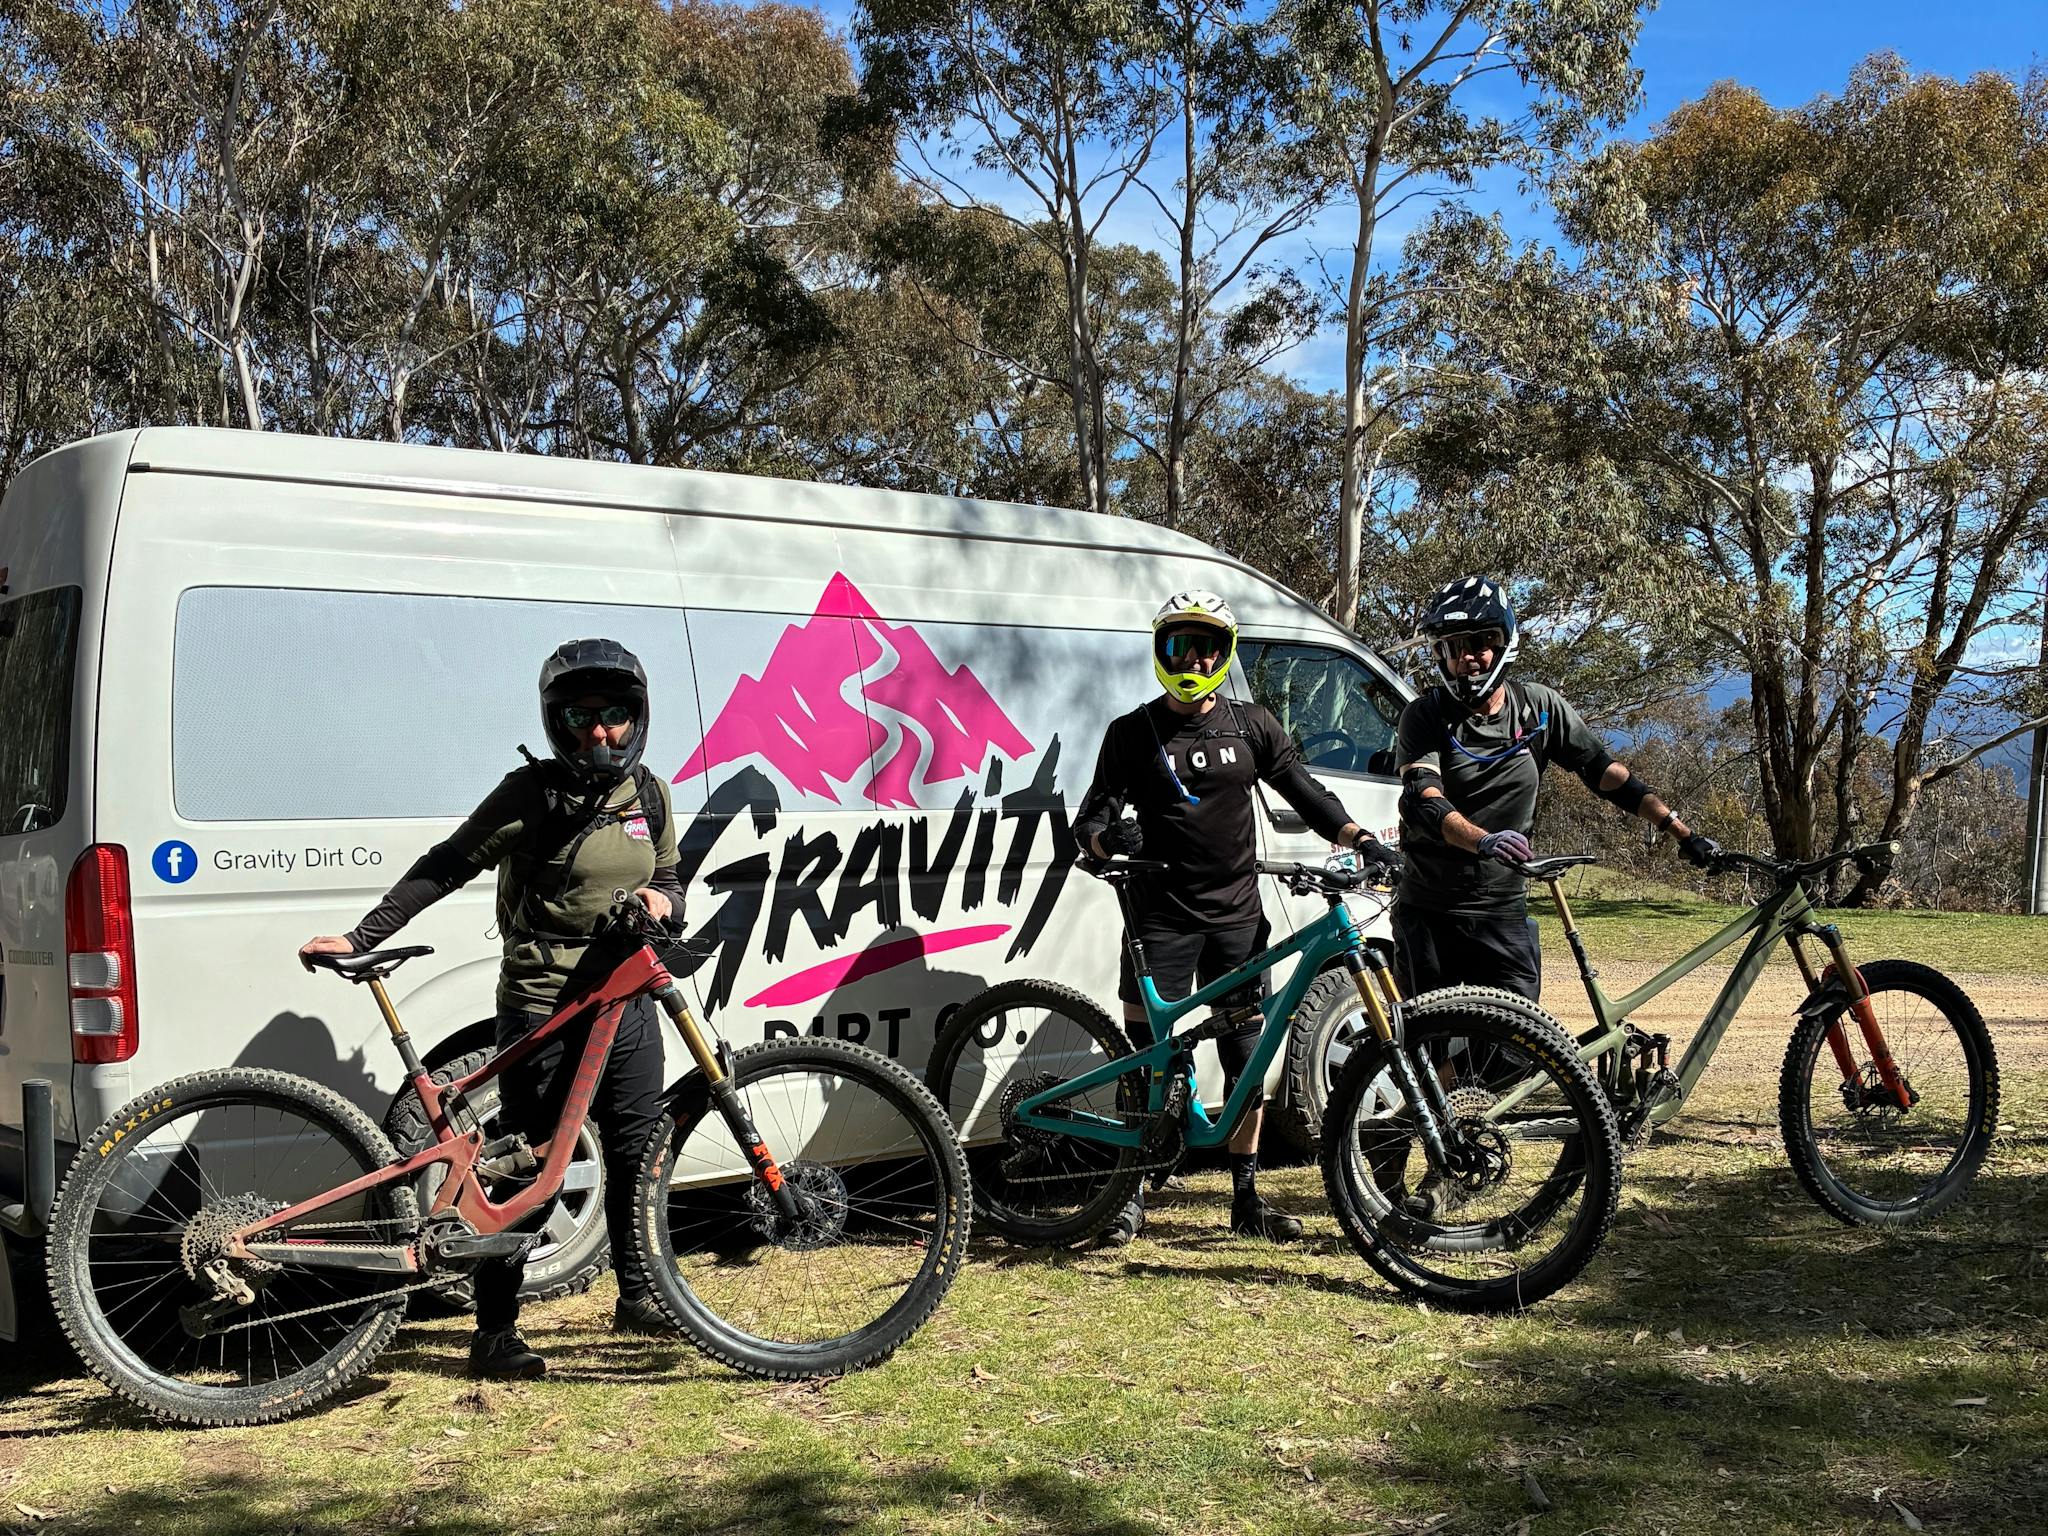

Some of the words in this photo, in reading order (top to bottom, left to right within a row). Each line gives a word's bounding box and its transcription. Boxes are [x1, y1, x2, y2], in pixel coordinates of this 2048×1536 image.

[213, 849, 297, 873] Gravity
[305, 846, 344, 868] Dirt
[351, 846, 382, 866] Co
[1511, 1033, 1573, 1084] MAXXIS
[98, 1098, 173, 1158] MAXXIS
[1982, 1070, 1994, 1134] MAXXIS
[935, 1194, 957, 1277] MAXXIS
